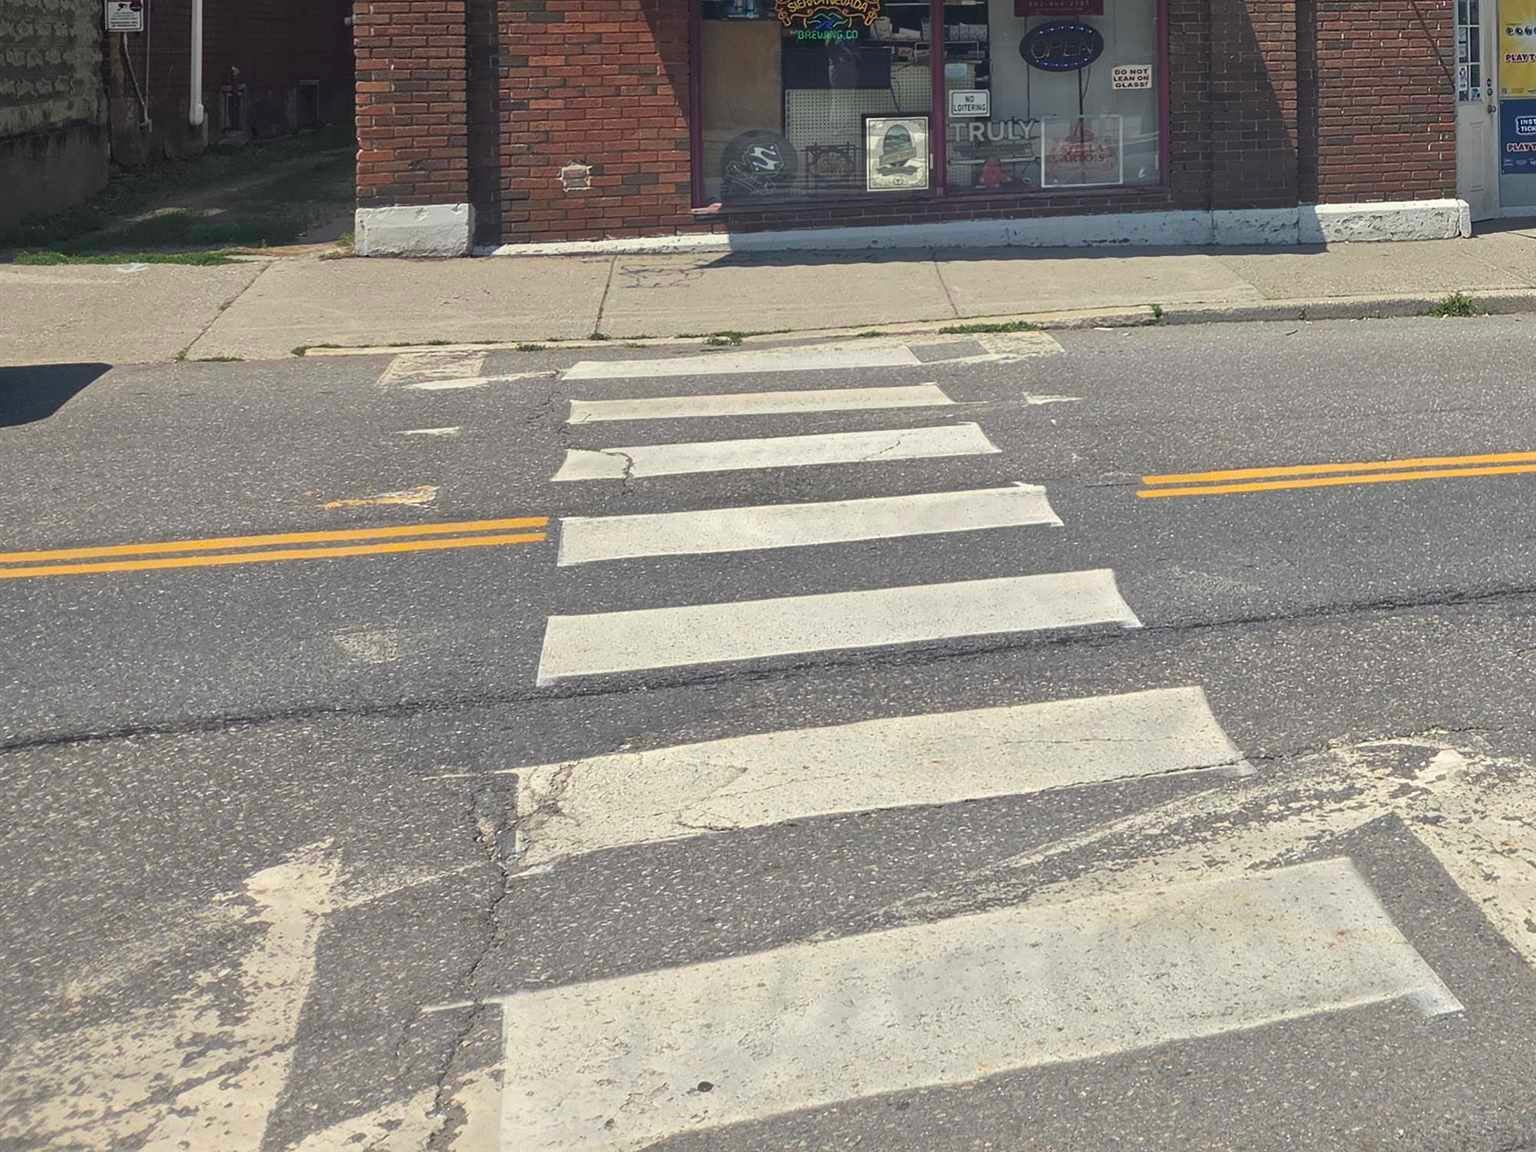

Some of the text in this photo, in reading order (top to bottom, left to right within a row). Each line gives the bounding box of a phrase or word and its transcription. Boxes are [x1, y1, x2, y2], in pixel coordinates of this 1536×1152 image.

[1505, 53, 1528, 63] PLAY
[964, 95, 975, 103] NO
[953, 103, 986, 112] LOITERING
[949, 120, 1034, 142] TRULY
[1507, 142, 1530, 152] PLAY
